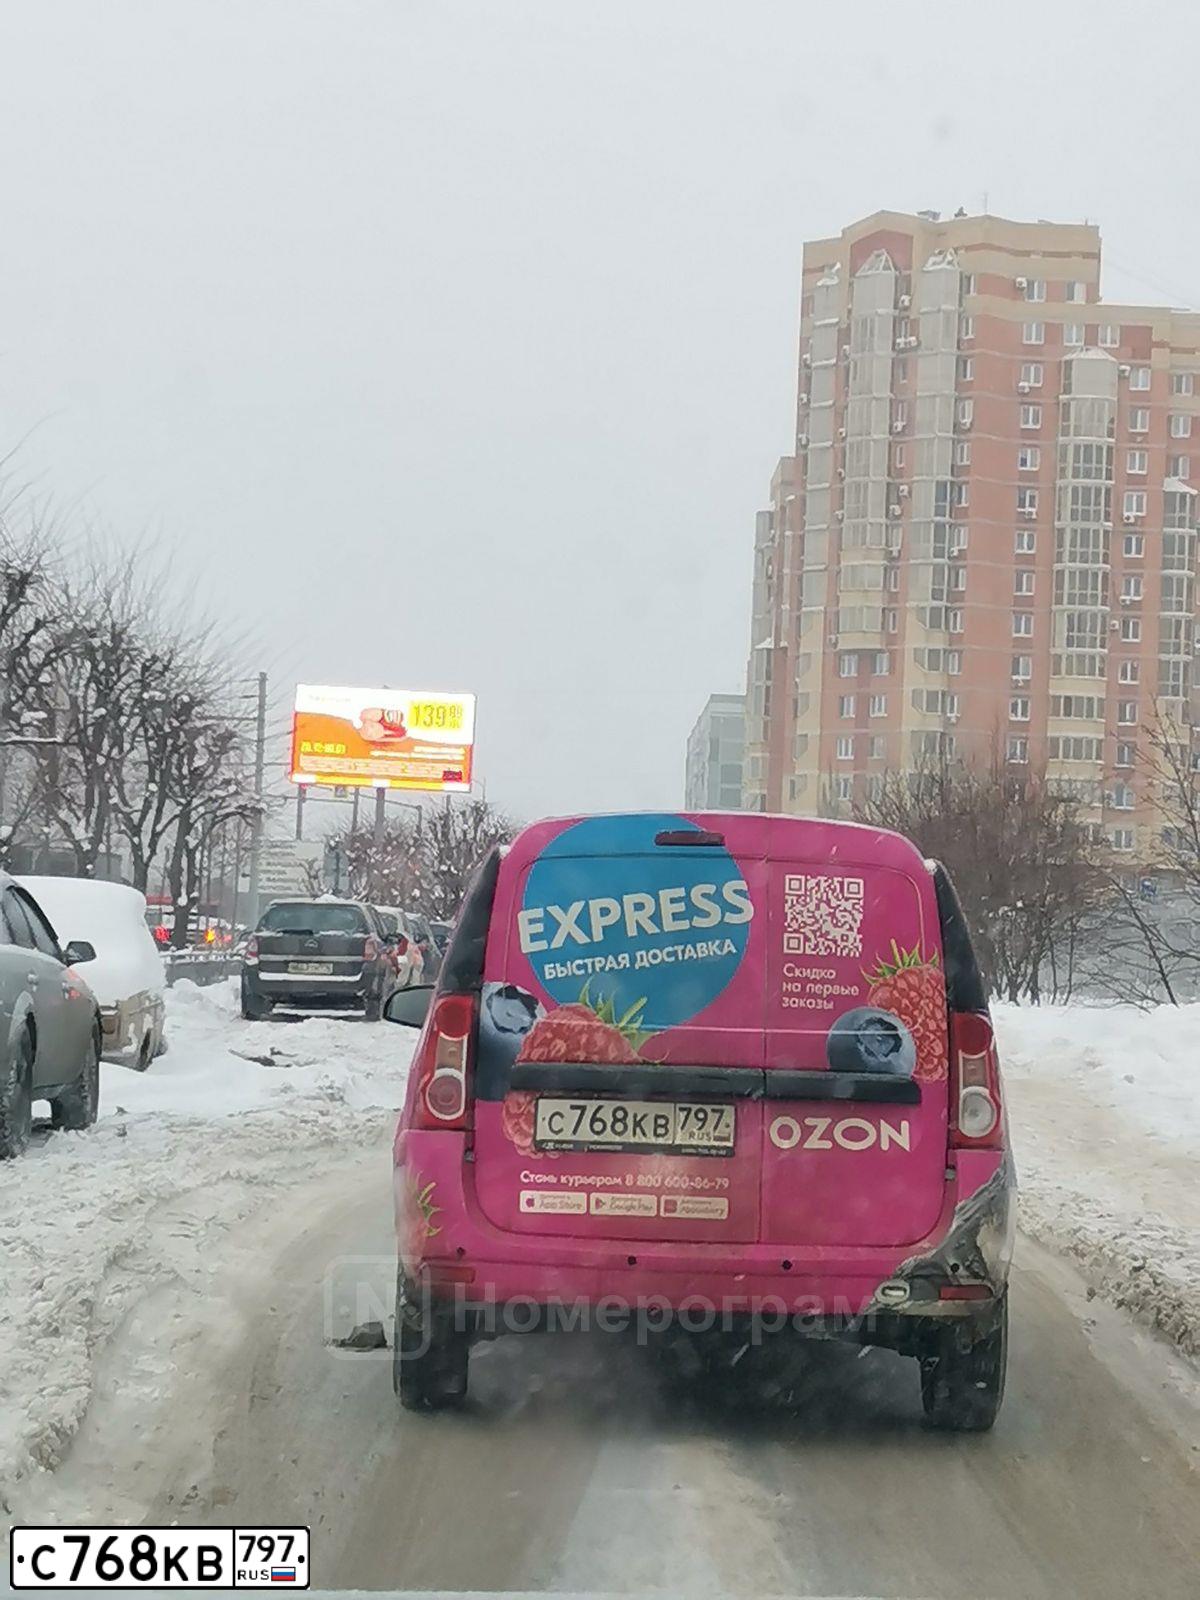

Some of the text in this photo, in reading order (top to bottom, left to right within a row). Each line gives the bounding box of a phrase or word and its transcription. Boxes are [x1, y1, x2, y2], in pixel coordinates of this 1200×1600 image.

[413, 704, 447, 728] 139
[517, 880, 755, 953] EXPRESS
[543, 938, 737, 980] БЫСТРАЯ ДОСТАВКА
[806, 982, 860, 998] первые
[782, 997, 834, 1010] заказы
[678, 1107, 726, 1132] 797
[688, 1131, 712, 1142] RUS
[769, 1116, 910, 1152] OZON
[560, 1174, 622, 1188] курьером
